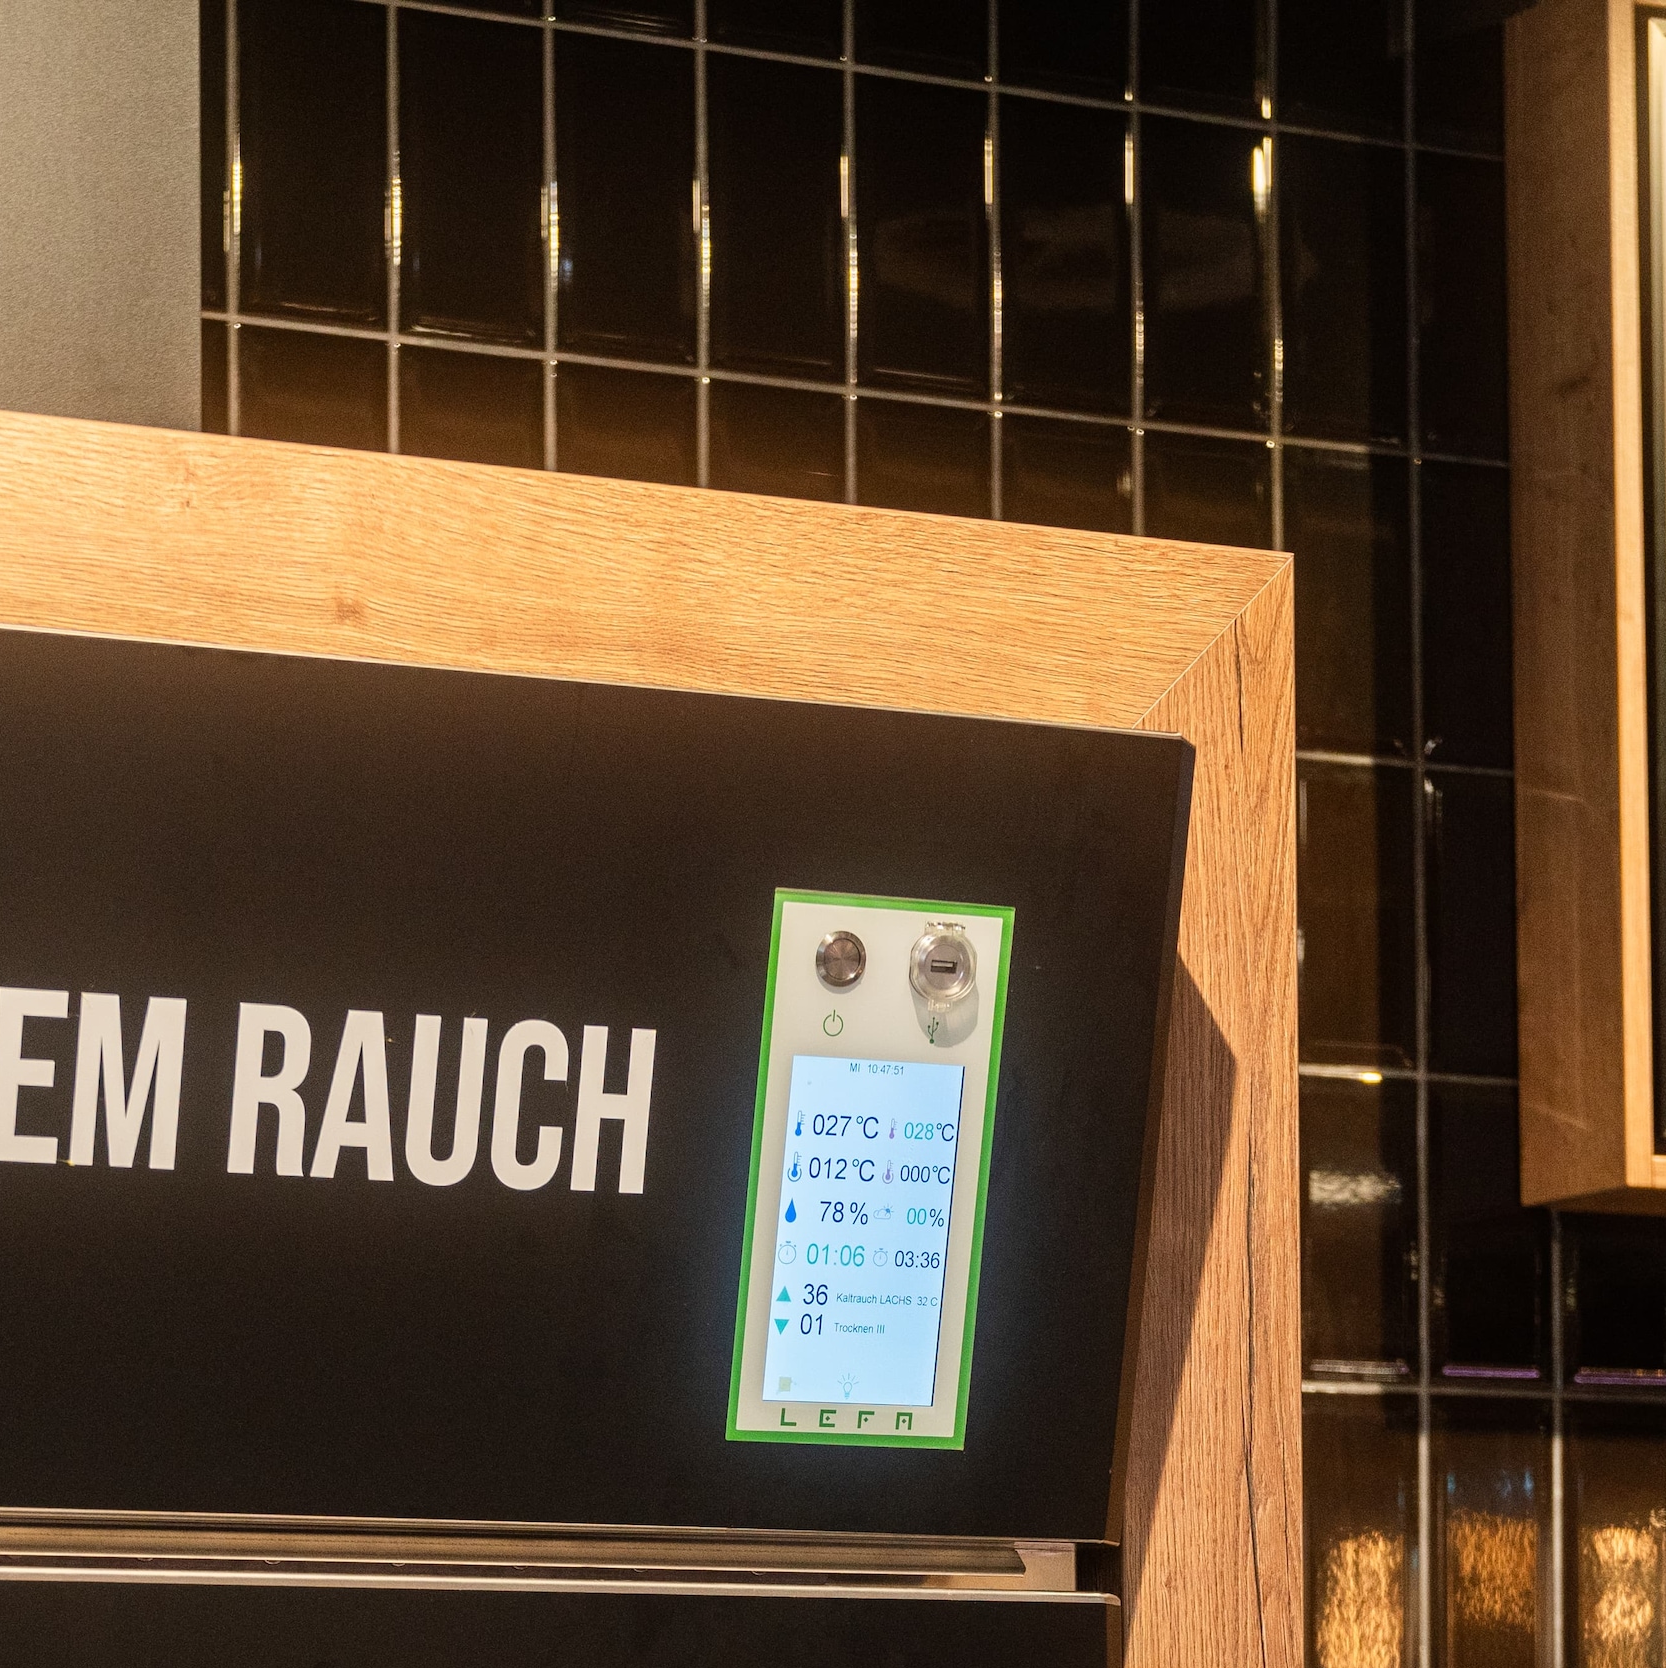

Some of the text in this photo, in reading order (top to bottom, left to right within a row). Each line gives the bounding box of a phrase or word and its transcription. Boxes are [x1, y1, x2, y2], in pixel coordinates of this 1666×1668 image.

[868, 1064, 904, 1075] 10:47:51
[227, 1002, 656, 1194] RAUCH
[806, 1243, 865, 1267] 01:06
[894, 1250, 940, 1269] 03:36
[802, 1283, 938, 1307] 36 Kaltrauch LACHS 32 C
[800, 1313, 823, 1335] 01
[834, 1322, 873, 1334] Trocknen
